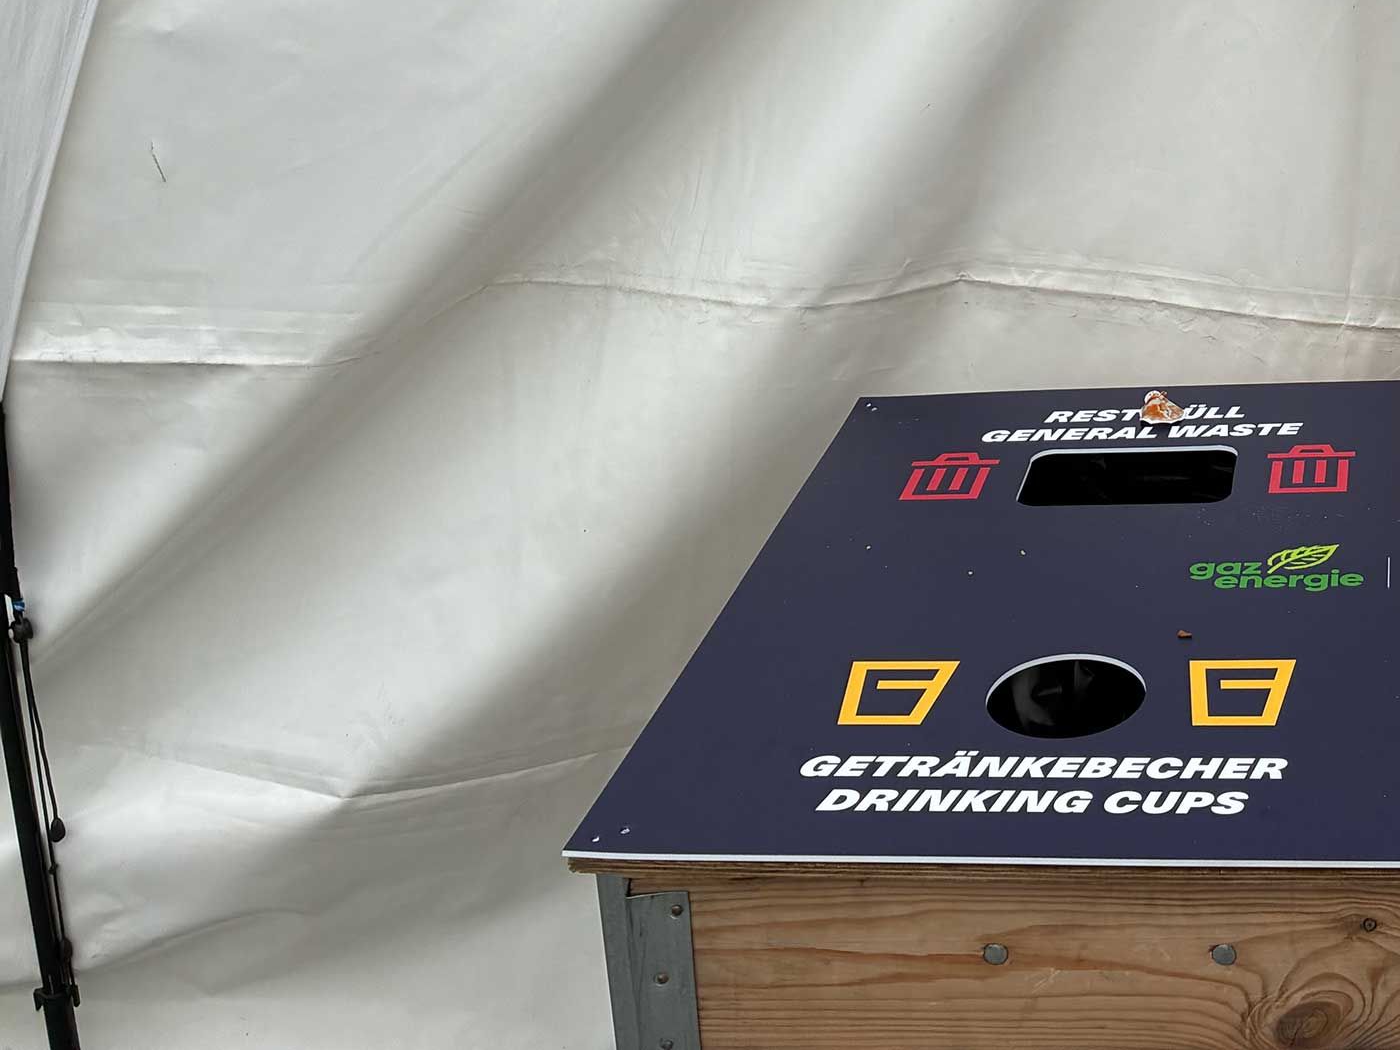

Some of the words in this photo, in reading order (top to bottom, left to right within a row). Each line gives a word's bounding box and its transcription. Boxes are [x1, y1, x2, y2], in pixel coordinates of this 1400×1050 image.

[1045, 404, 1245, 423] RESTÜLL
[982, 425, 1157, 442] GENERAL
[1168, 422, 1303, 438] WASTE
[1189, 562, 1262, 580] gaz
[1214, 569, 1364, 591] energie
[800, 750, 1288, 781] GETRÄNKEBECHER
[815, 788, 1094, 814] DRINKING
[1103, 790, 1249, 816] CUPS
